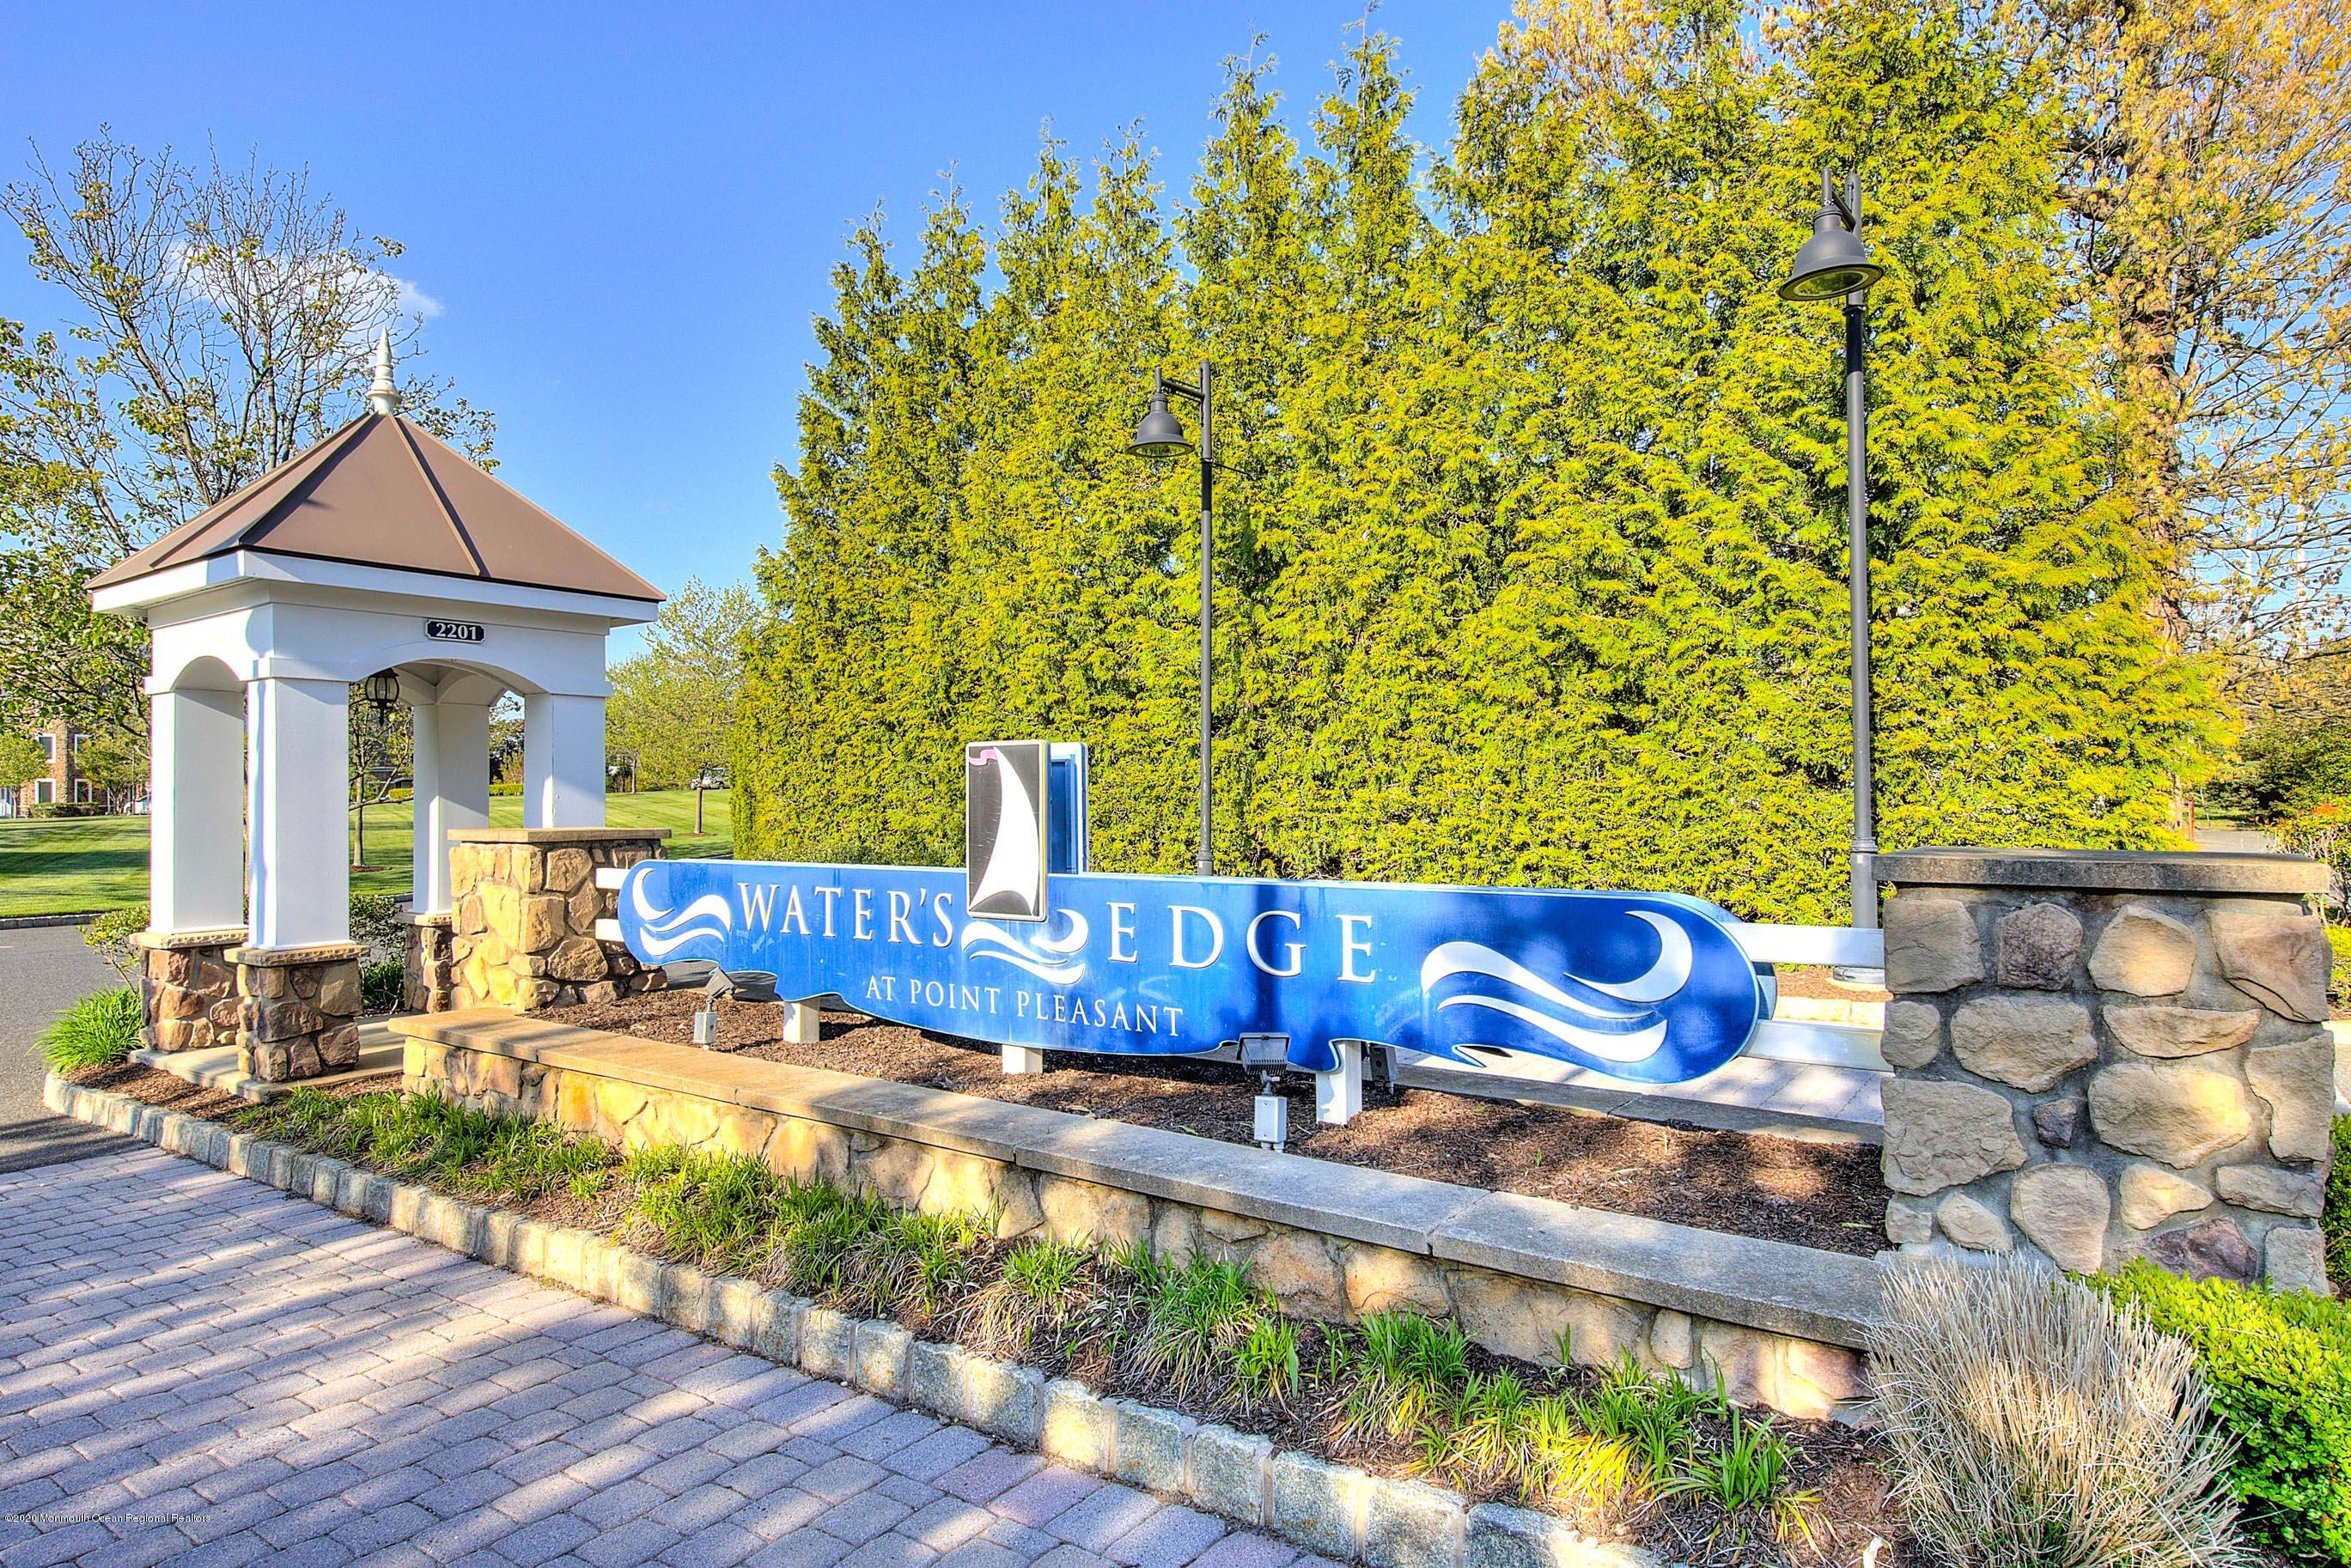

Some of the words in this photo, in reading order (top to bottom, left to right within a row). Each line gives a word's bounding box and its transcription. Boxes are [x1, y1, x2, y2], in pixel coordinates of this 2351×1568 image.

[435, 623, 477, 641] 2201
[737, 882, 953, 948] WATER'S
[1106, 902, 1377, 984] EDGE
[866, 975, 896, 1000] AT
[911, 979, 1001, 1015] POINT
[1016, 990, 1184, 1037] PLEASANT
